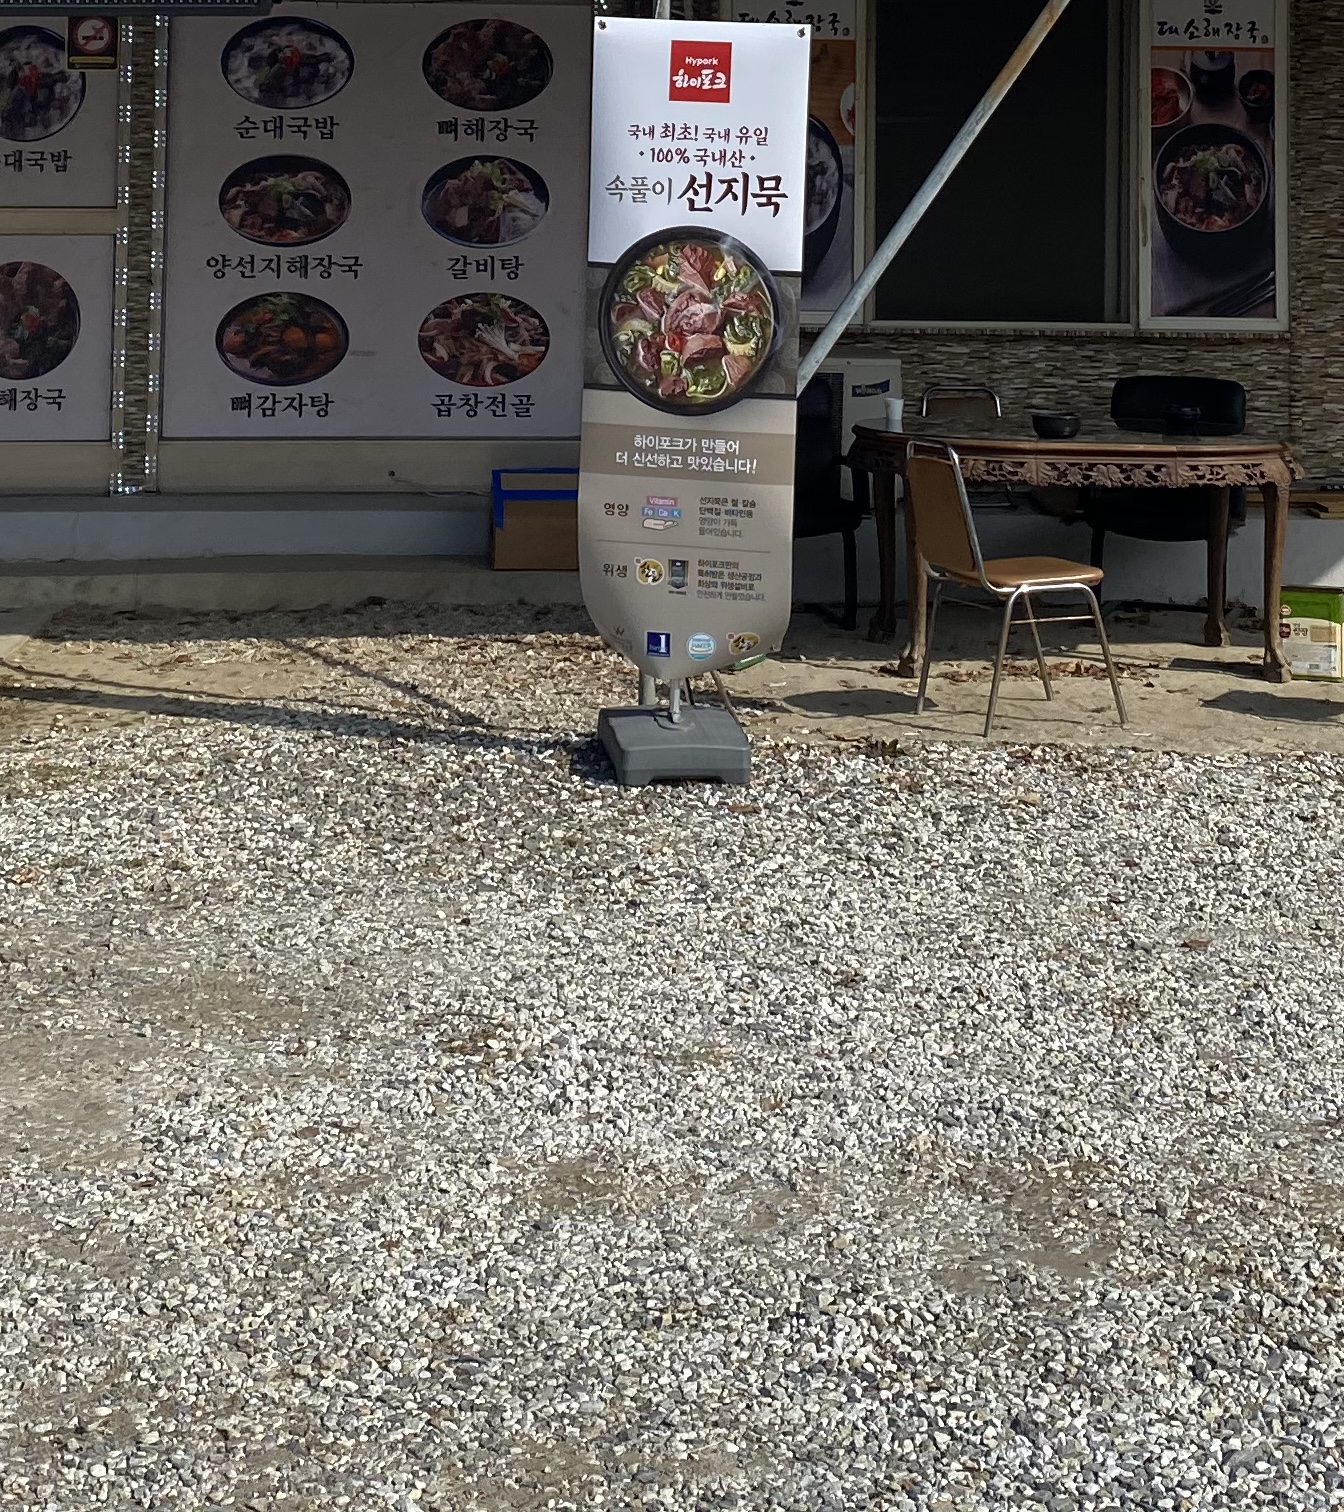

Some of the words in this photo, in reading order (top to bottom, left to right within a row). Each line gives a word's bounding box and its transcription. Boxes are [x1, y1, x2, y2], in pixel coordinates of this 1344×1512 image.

[685, 56, 719, 66] Hypork
[672, 69, 727, 89] 하이포크
[233, 115, 339, 141] 순대국밥
[436, 116, 539, 143] 뼈해장국
[627, 124, 655, 140] 국내
[659, 122, 699, 142] 최초!
[702, 127, 730, 144] 국내
[735, 126, 769, 146] 유일
[605, 174, 673, 205] 속풀이
[677, 171, 789, 218] 선지묵
[205, 254, 364, 282] 양선지해장국
[446, 254, 524, 281] 갈비탕
[230, 392, 335, 419] 뼈감자탕
[431, 392, 535, 419] 곱창전골
[634, 434, 698, 453] 하이포크가
[701, 439, 740, 456] 만들어
[615, 452, 628, 466] 더
[632, 452, 683, 469] 신선하고
[687, 456, 757, 475] 맛있습니다!
[603, 502, 630, 517] 영양
[649, 496, 675, 506] Vitamin
[603, 563, 628, 578] 위생
